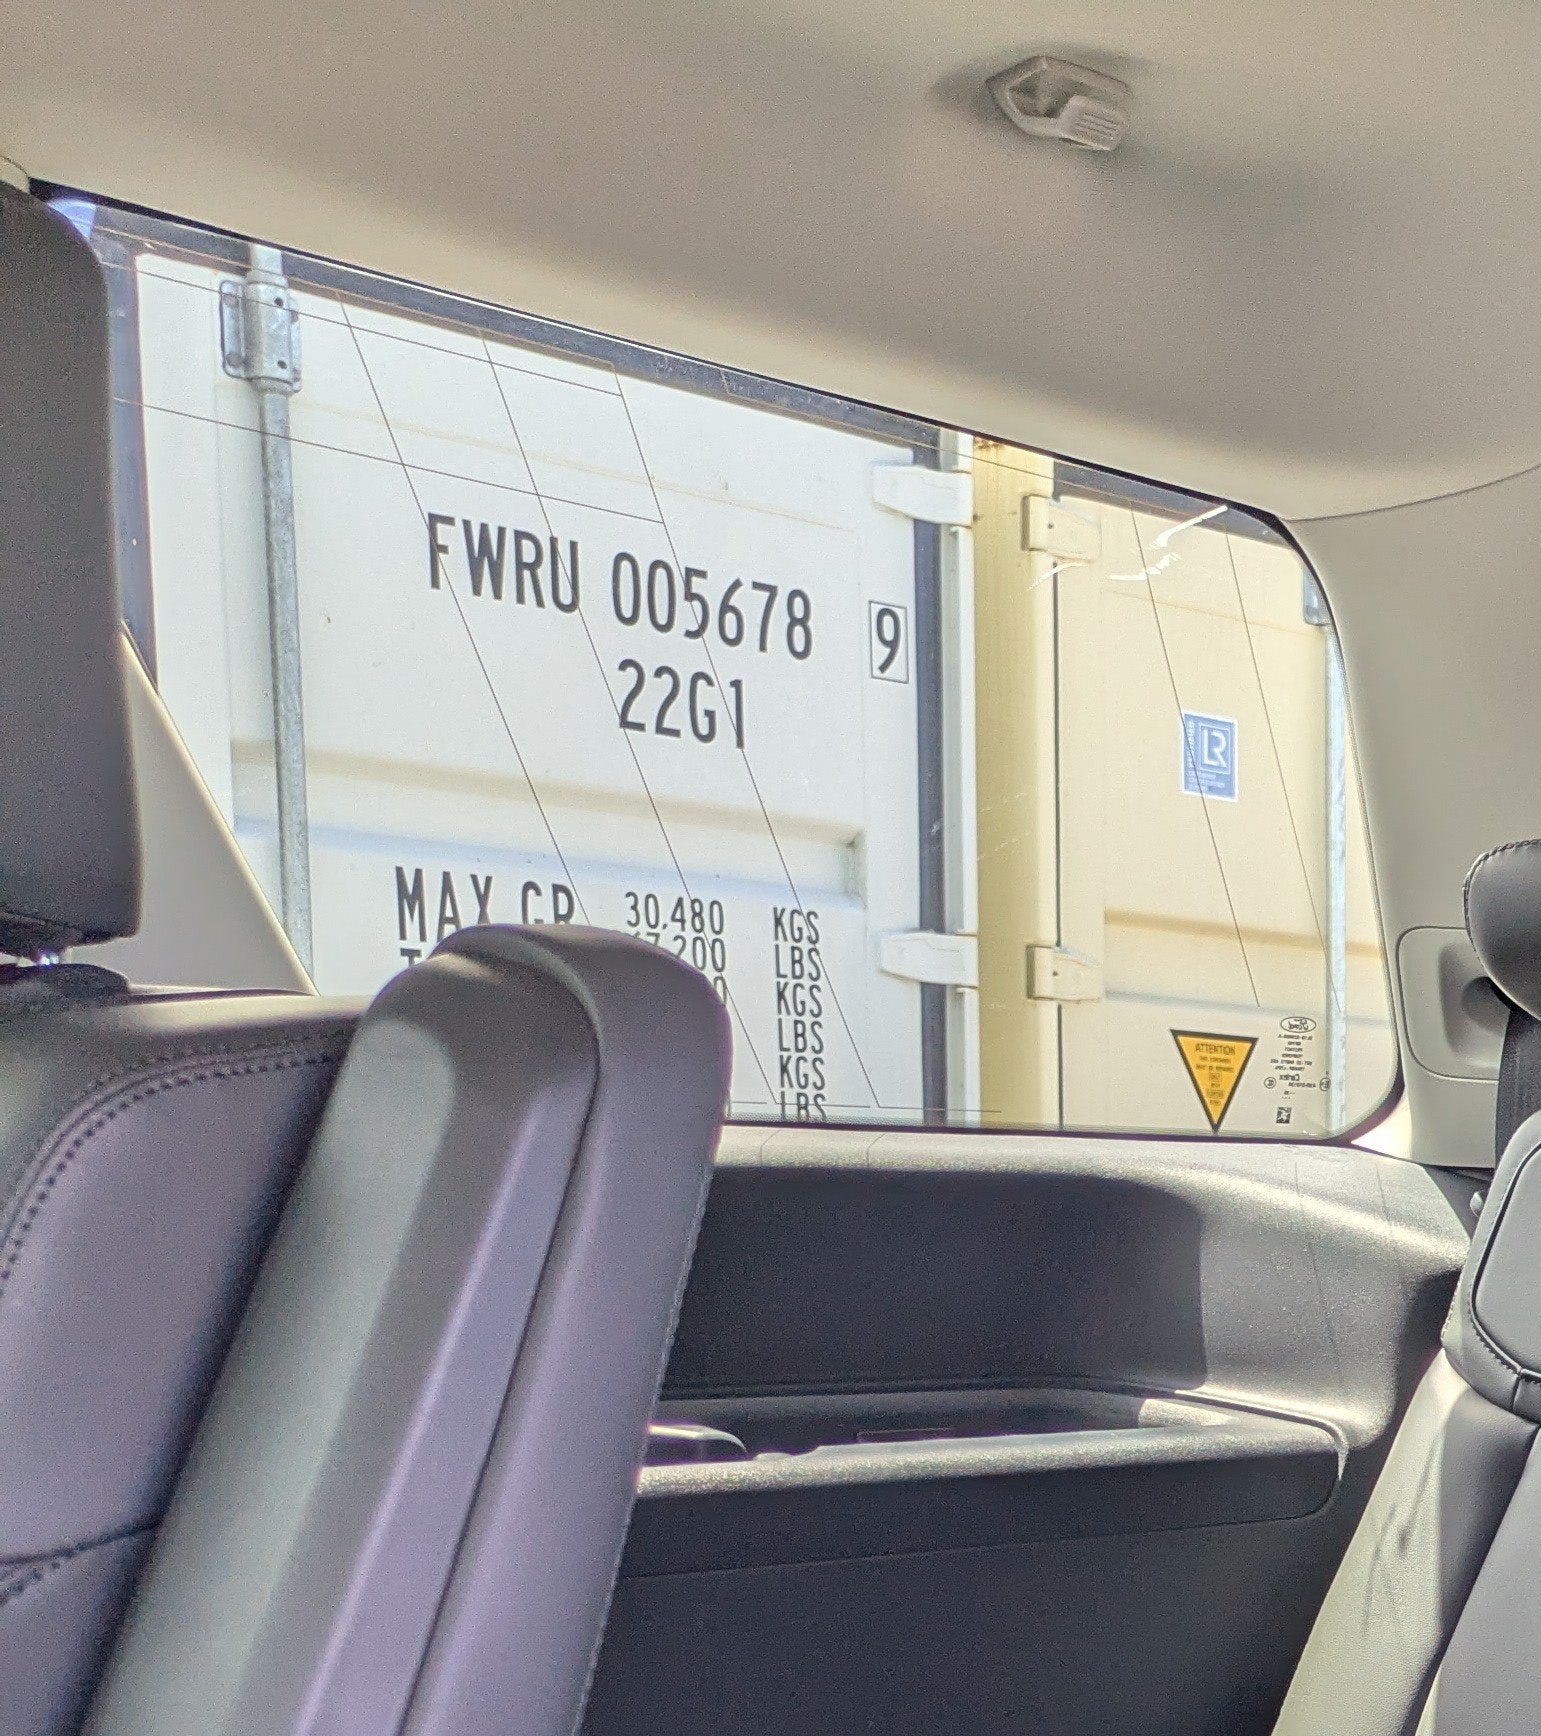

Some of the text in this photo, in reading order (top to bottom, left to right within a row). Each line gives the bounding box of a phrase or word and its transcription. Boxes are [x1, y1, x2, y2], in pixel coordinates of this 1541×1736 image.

[427, 512, 901, 675] FWRU 005678 9
[618, 658, 744, 750] 22G1
[396, 866, 493, 942] MAX
[773, 907, 820, 945] KGS
[775, 943, 821, 982] LBS
[776, 981, 823, 1019] KGS
[777, 1018, 824, 1055] LBS
[1195, 1043, 1236, 1056] ATTENTION
[779, 1054, 826, 1091] KGS
[780, 1090, 827, 1122] LBS
